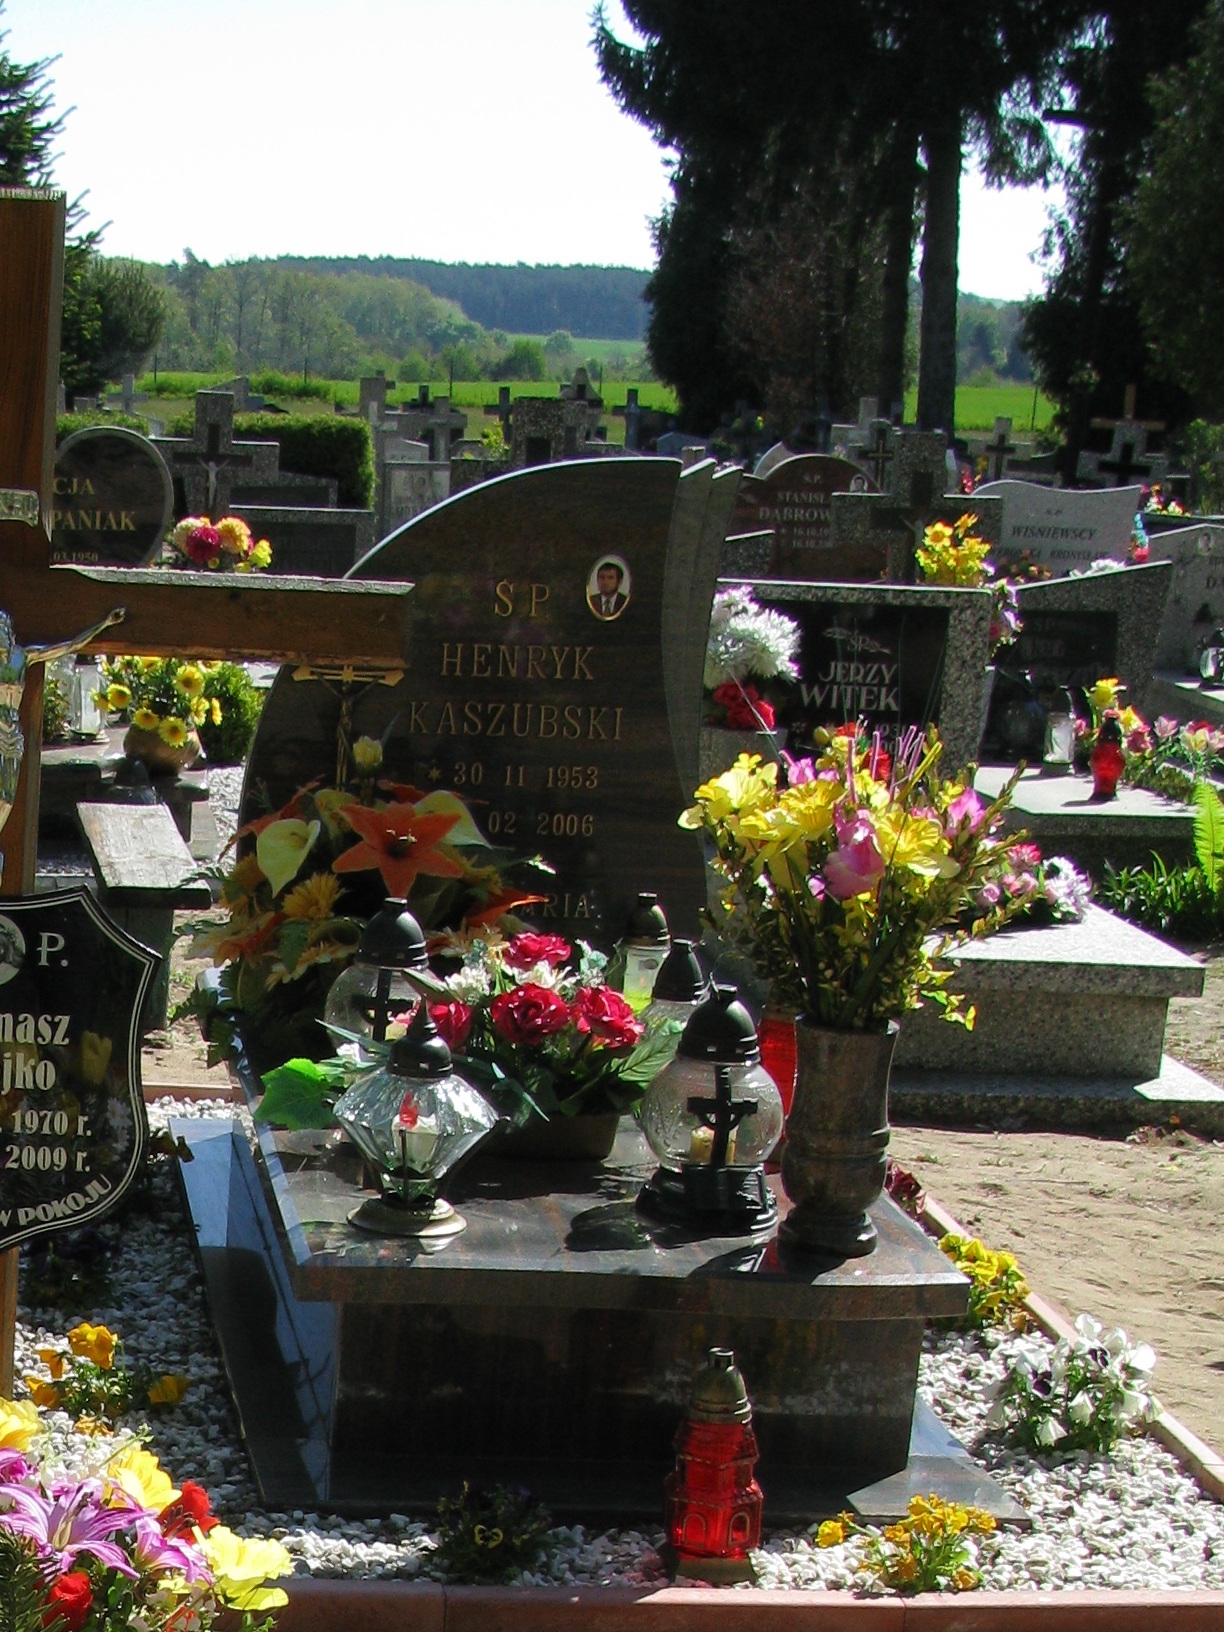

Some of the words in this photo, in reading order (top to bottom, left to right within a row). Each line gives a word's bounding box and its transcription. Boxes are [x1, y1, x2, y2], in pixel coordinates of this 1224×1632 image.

[441, 643, 595, 680] HENRYK
[819, 661, 897, 684] JERZY
[800, 684, 900, 711] WITEK
[409, 701, 624, 741] KASZUBSKI
[454, 761, 483, 785] 30
[504, 764, 525, 786] 11
[546, 765, 599, 789] 1953
[488, 811, 516, 834] 02
[537, 812, 594, 837] 2006
[518, 893, 591, 918] ARIA
[12, 1109, 69, 1136] 1970
[77, 1114, 92, 1137] r.
[5, 1144, 67, 1172] 2009
[76, 1149, 91, 1173] r.
[17, 1173, 112, 1226] POKOJU
